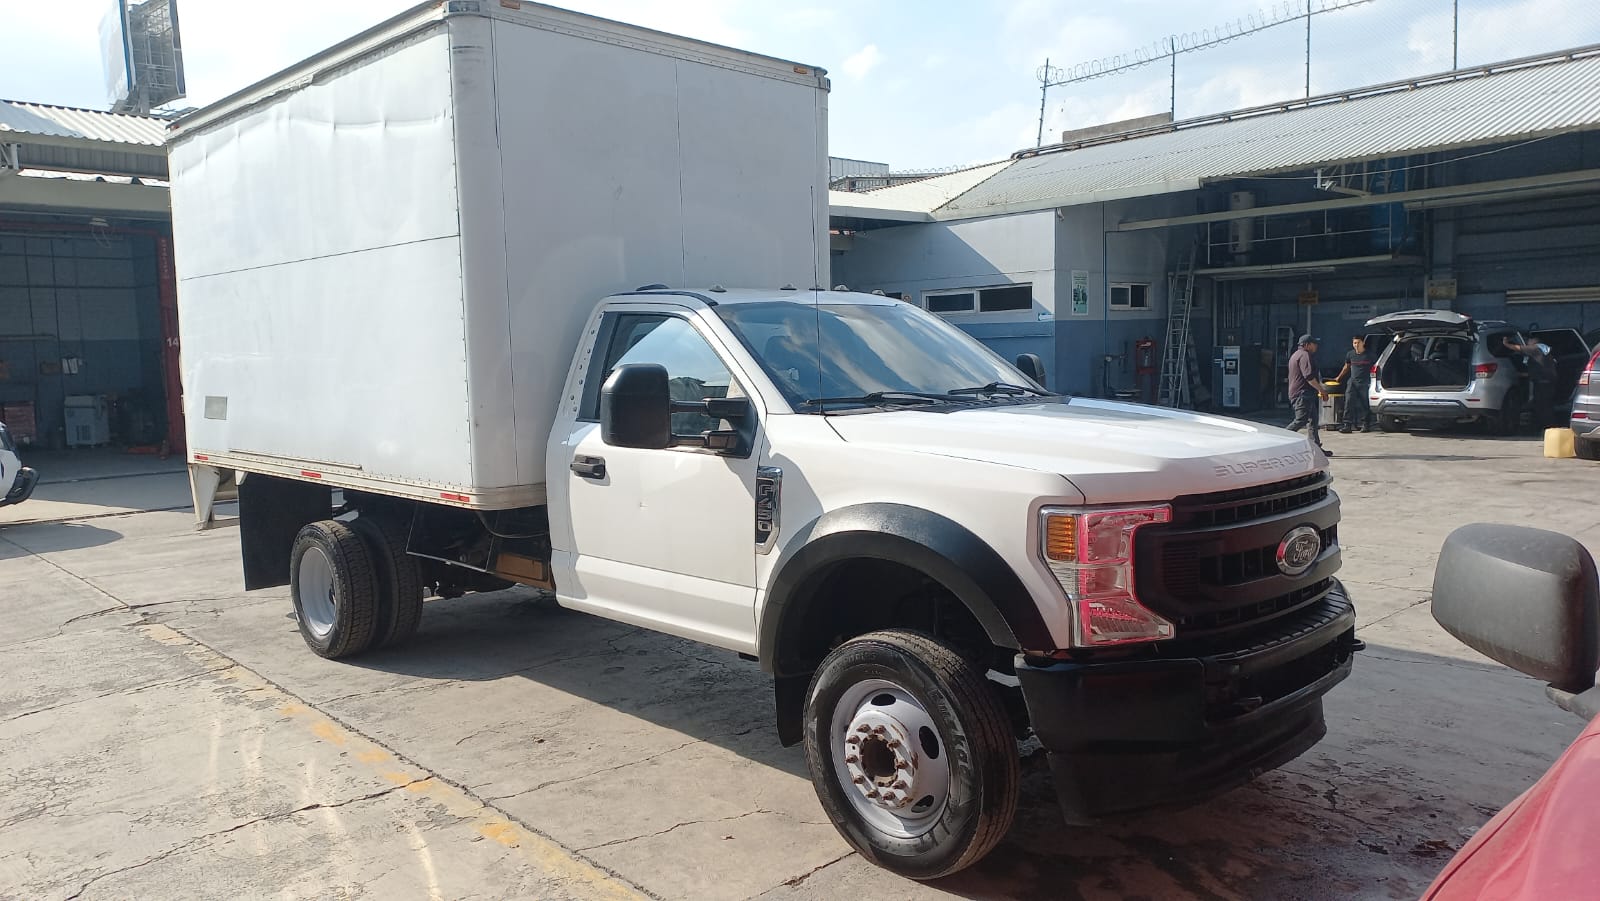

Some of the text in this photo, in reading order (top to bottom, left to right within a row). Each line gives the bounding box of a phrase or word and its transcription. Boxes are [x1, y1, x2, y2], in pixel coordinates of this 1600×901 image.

[166, 336, 179, 347] 14
[1214, 450, 1316, 477] SUPER DUT
[1293, 540, 1317, 562] Ford
